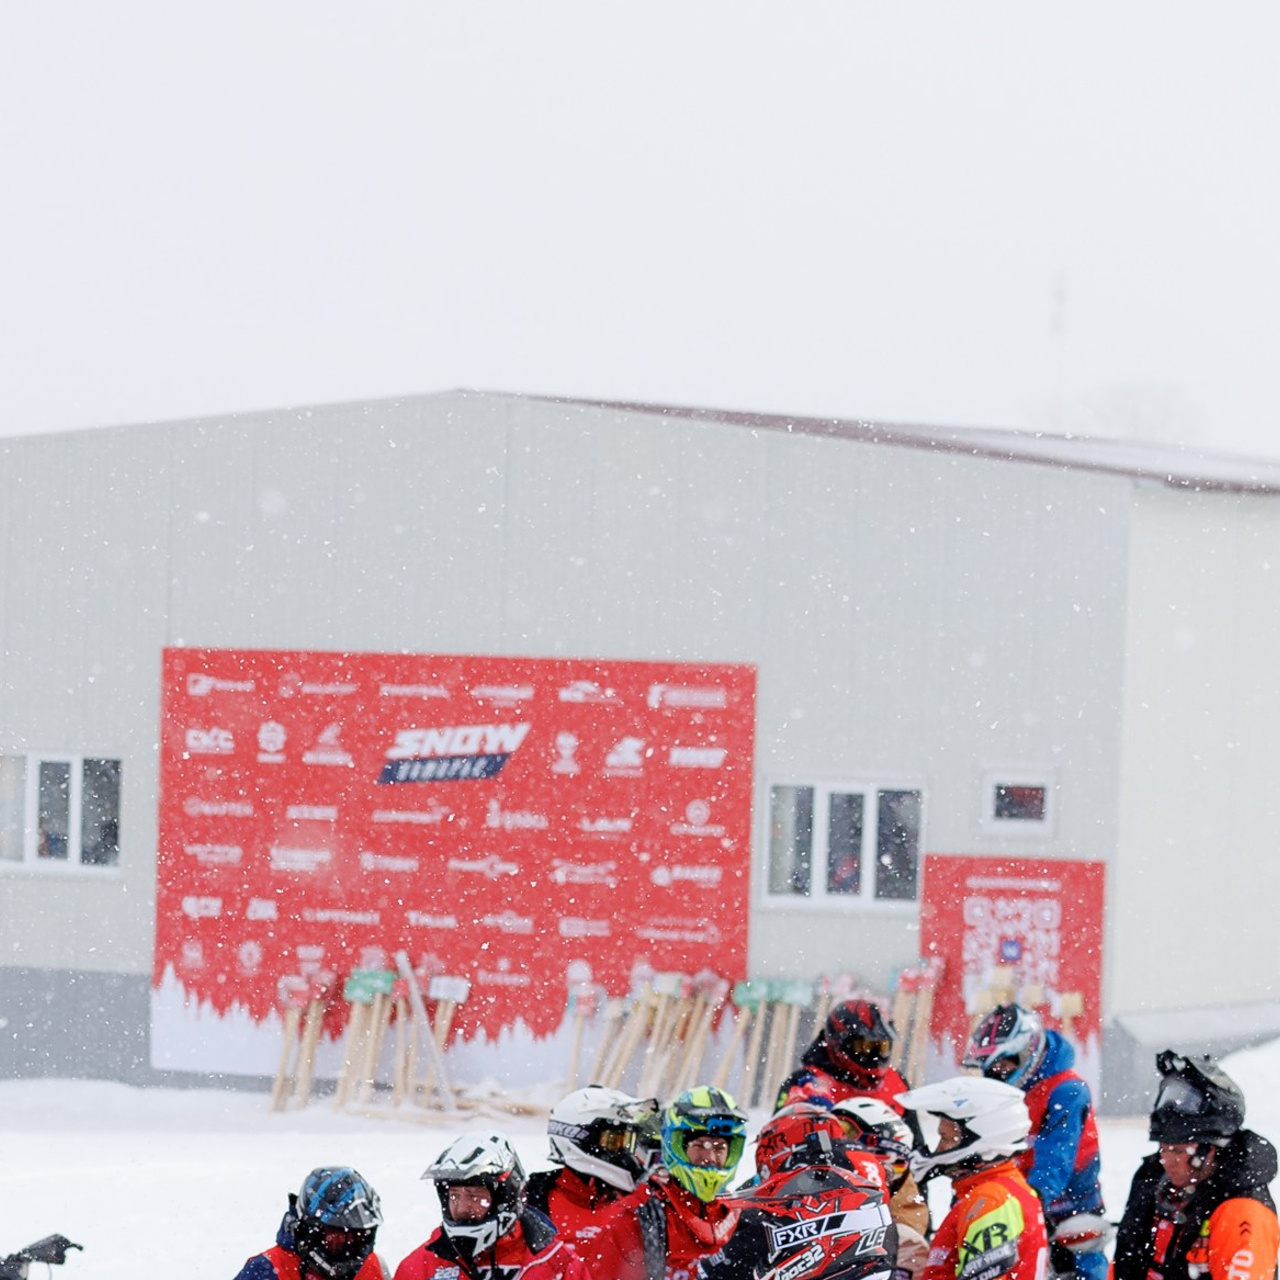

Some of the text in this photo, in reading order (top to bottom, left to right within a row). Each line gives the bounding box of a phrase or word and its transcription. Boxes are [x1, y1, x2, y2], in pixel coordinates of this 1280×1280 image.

[385, 721, 532, 761] SNOW
[776, 1222, 818, 1246] FXR
[960, 1222, 1009, 1267] XR
